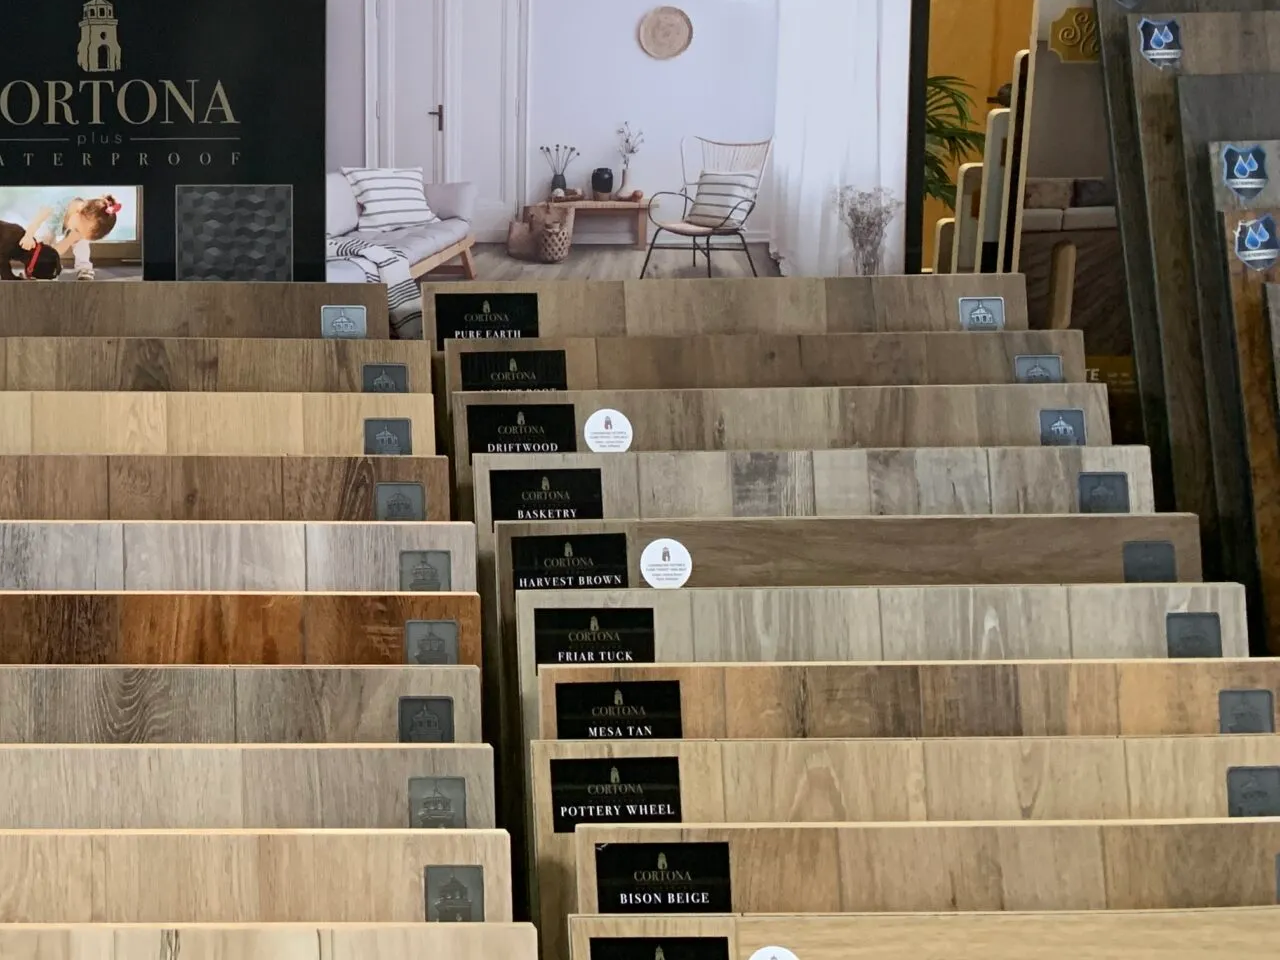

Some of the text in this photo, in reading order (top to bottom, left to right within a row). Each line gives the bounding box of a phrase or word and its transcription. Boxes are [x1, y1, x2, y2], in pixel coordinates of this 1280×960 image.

[76, 131, 123, 146] plus
[463, 312, 510, 323] CORTONA
[454, 329, 522, 339] PURE EARTH
[490, 371, 537, 382] CORTONA
[497, 424, 545, 435] CORTONA
[487, 442, 559, 453] DRIFTWOOD
[521, 490, 571, 501] CORTONA
[517, 508, 578, 519] BASKETRY
[544, 557, 595, 568] CORTONA
[519, 575, 623, 588] HARVEST BROWN
[568, 630, 621, 642] CORTONA
[557, 651, 634, 662] FRIAR TUCK
[591, 705, 646, 717] CORTONA
[588, 725, 652, 737] MESA TAN
[587, 783, 644, 795] CORTONA
[560, 803, 675, 817] POTTERY WHEEL
[633, 869, 692, 881] CORTONA
[620, 891, 710, 905] BISON BEIGE
